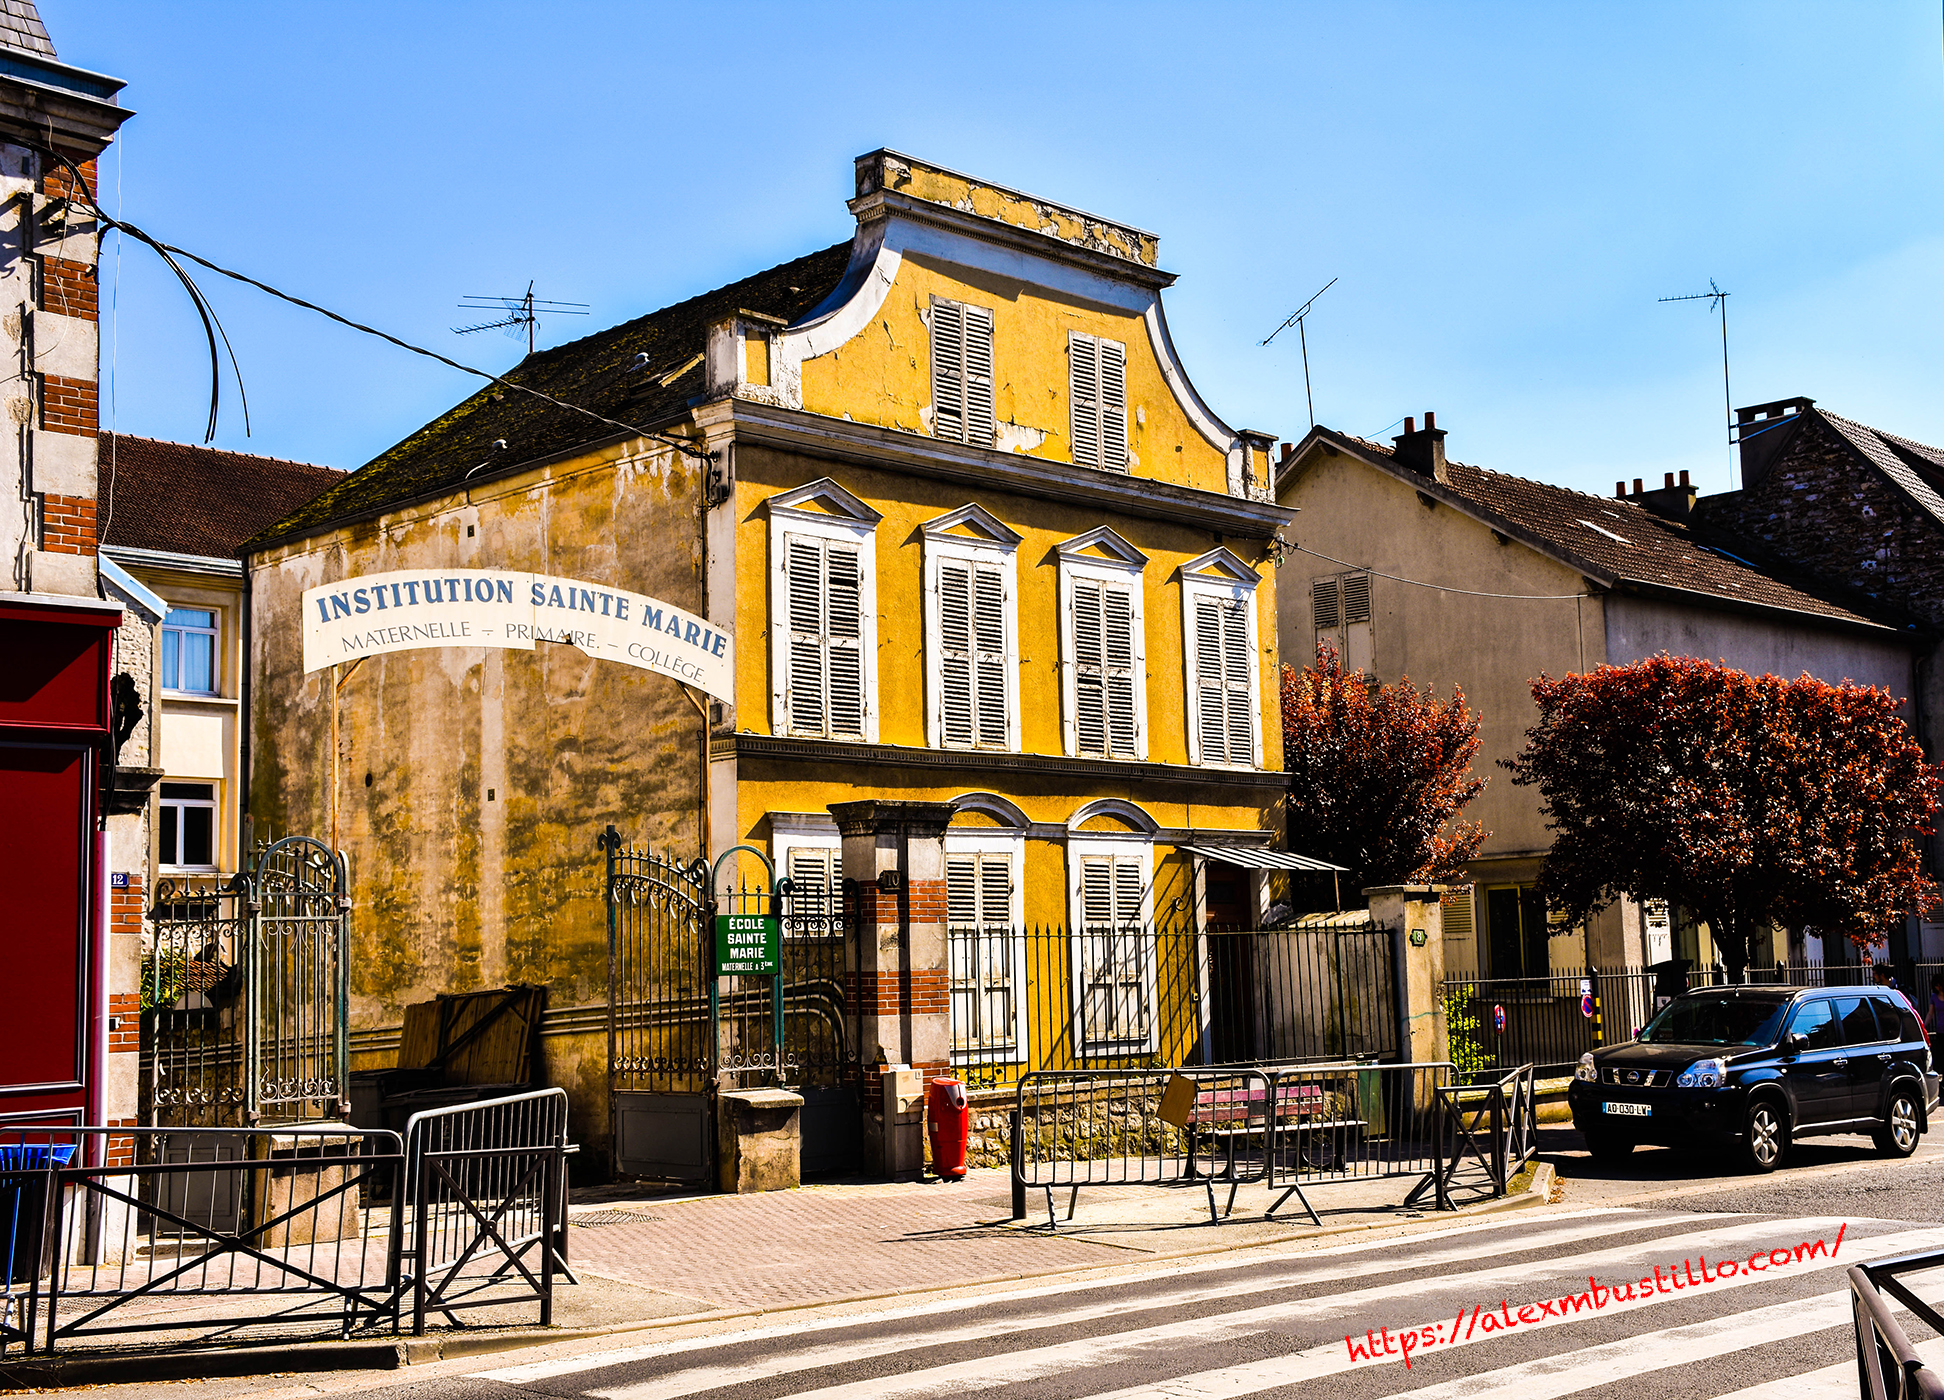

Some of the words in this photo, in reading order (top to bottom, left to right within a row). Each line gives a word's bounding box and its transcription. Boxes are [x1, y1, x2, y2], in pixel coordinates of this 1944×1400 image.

[316, 578, 513, 623] INSTITUTION
[530, 582, 629, 621] SAINTE
[641, 604, 727, 658] MARIE
[341, 621, 472, 653] MATERNELLE
[506, 623, 597, 649] PRIMAIRE
[112, 874, 124, 885] 12
[887, 872, 901, 886] 10
[729, 917, 765, 930] ÉCOLE
[727, 933, 767, 944] SAINTE
[1416, 931, 1422, 941] 8
[730, 947, 765, 959] MARIE
[721, 962, 753, 971] MATERNELLE
